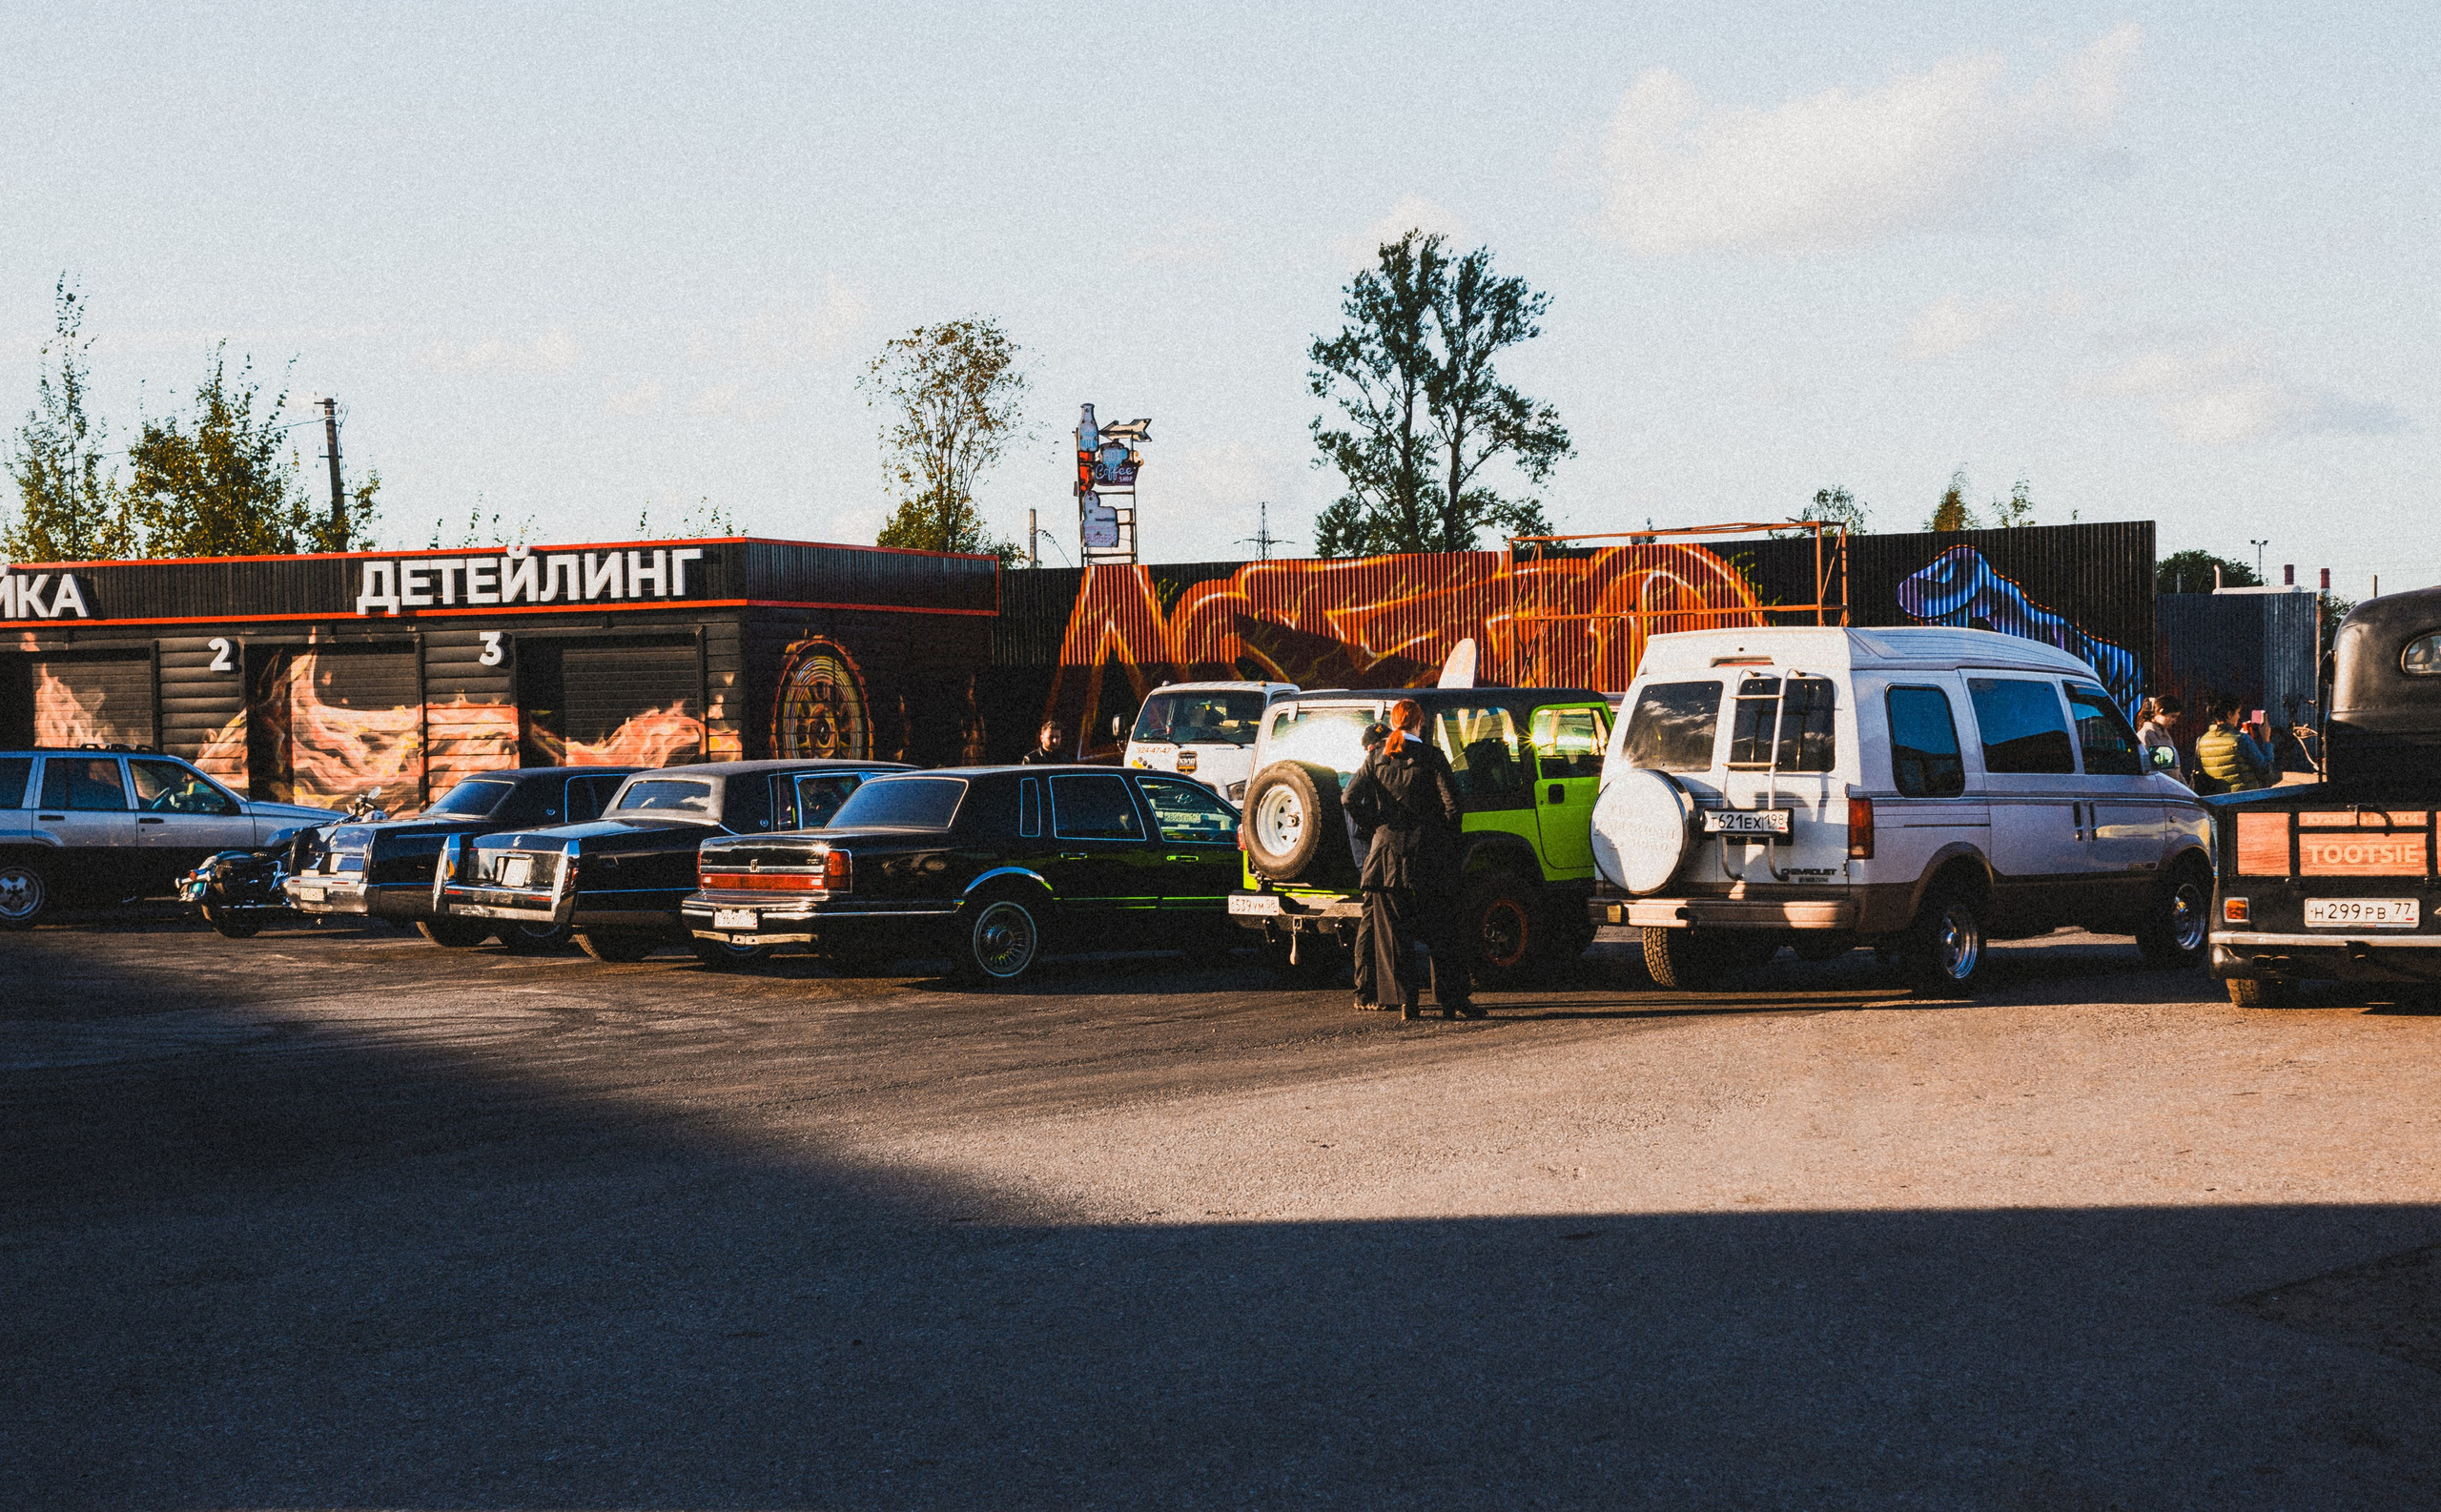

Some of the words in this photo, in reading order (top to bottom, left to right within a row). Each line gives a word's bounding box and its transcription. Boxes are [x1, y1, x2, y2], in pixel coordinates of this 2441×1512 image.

[1103, 450, 1122, 461] HOT
[1095, 463, 1134, 481] Coffee
[357, 546, 704, 616] ДЕТЕЙЛИНГ
[208, 638, 233, 671] 2
[479, 631, 505, 666] 3
[1711, 813, 1762, 829] Т621ЕХ
[1764, 813, 1784, 826] 198
[2307, 813, 2350, 825] КУХНЯ
[2351, 813, 2419, 825] МЕИКИ
[2307, 844, 2419, 864] TOOTSIE
[2394, 903, 2411, 915] 77
